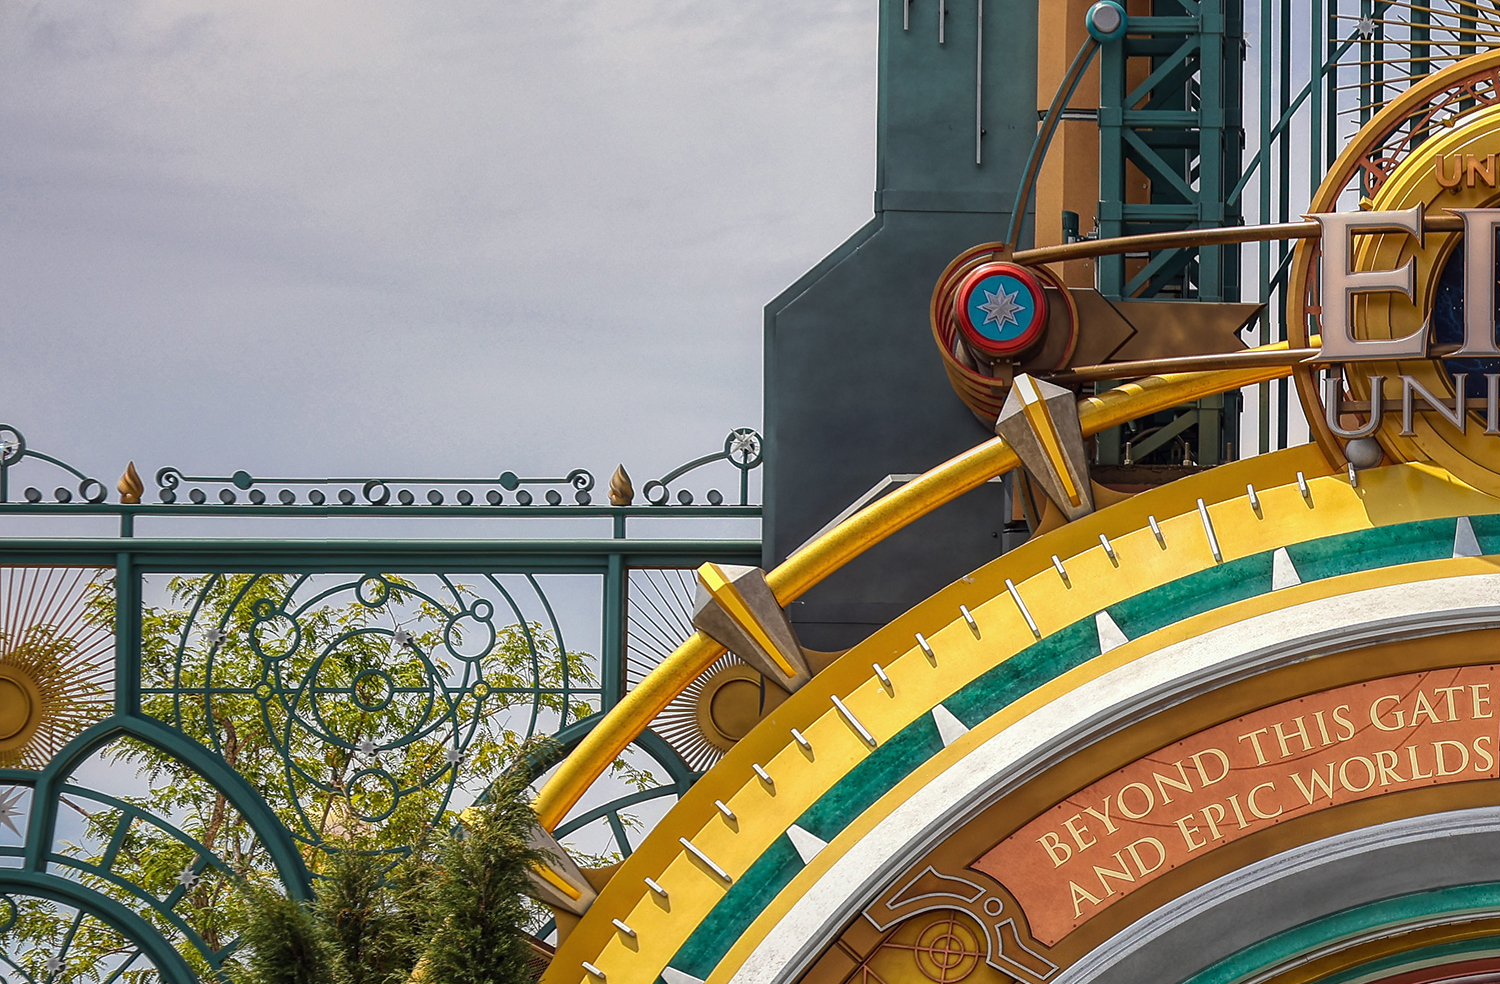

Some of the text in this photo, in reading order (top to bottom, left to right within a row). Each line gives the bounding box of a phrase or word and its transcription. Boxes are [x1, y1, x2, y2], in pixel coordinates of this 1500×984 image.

[1036, 748, 1230, 869] BEYOND
[1238, 704, 1355, 766] THIS
[1370, 683, 1494, 732] GATE
[1066, 836, 1166, 919] AND
[1173, 781, 1284, 852] EPIC
[1289, 736, 1494, 806] WORLDS
